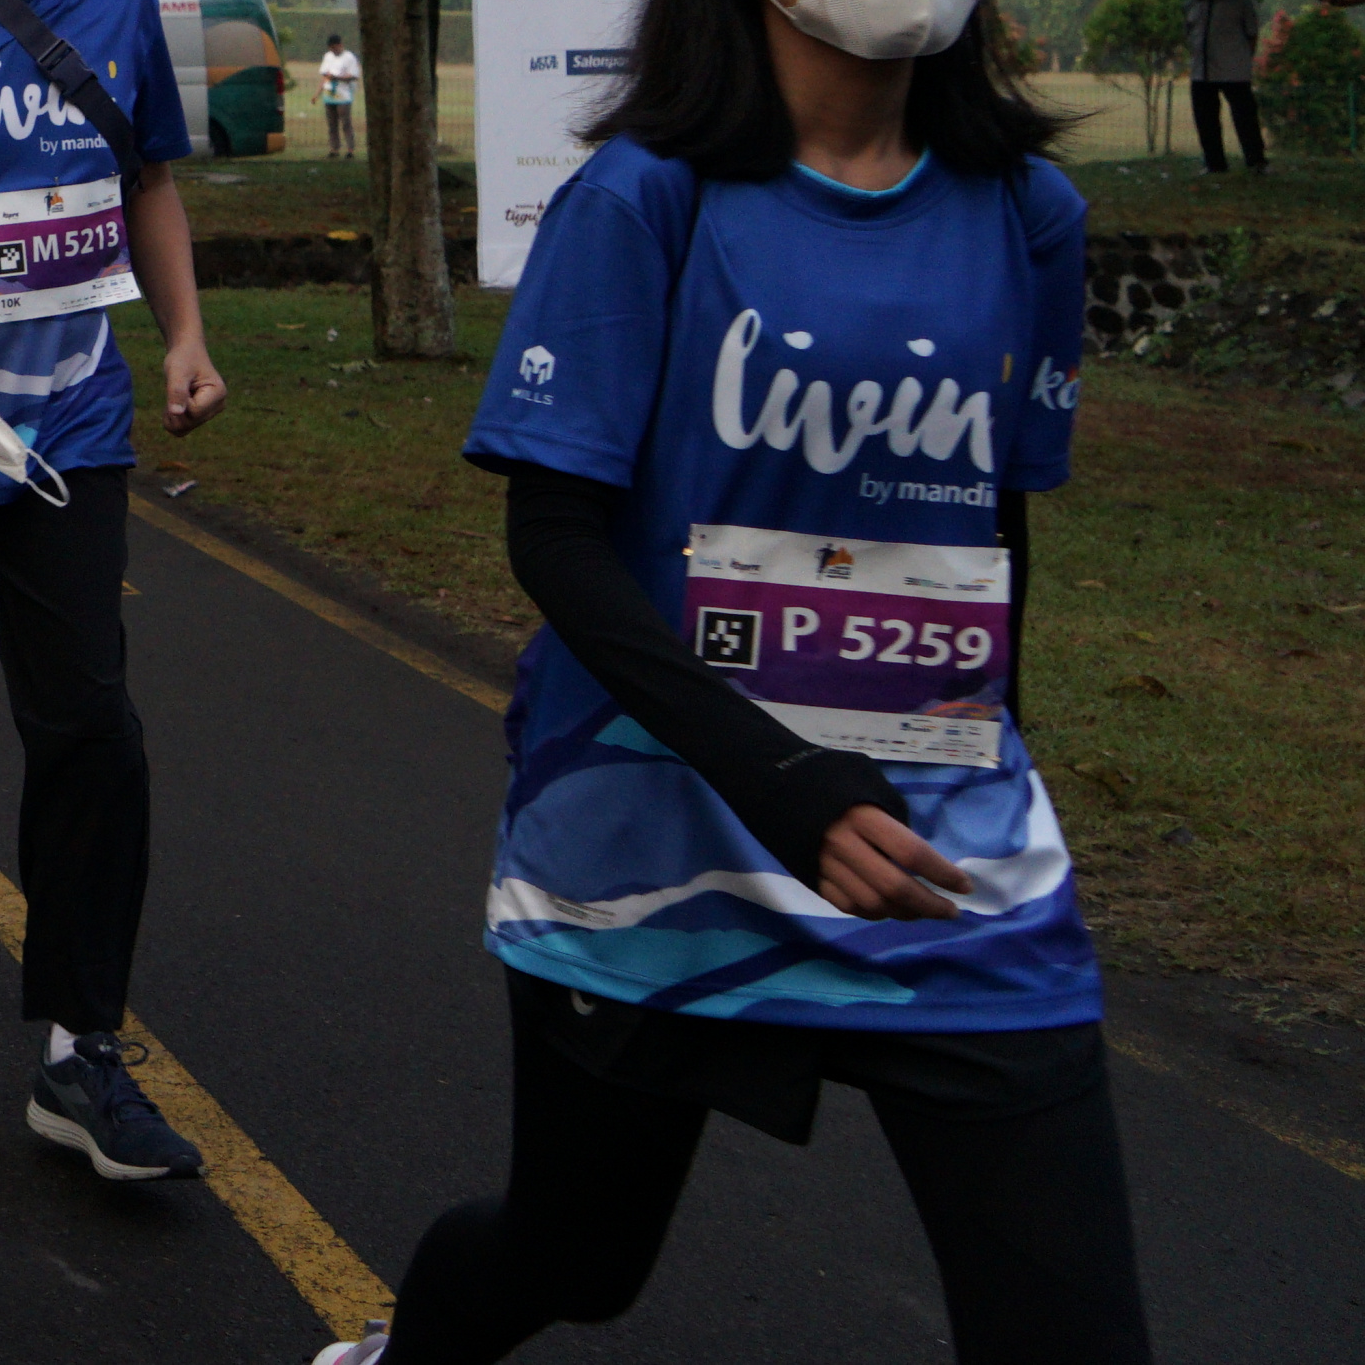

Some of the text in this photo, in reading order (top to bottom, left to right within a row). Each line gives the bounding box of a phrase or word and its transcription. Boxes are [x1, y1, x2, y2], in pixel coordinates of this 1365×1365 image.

[39, 136, 59, 156] by
[516, 155, 559, 167] ROYAL
[32, 221, 120, 263] M 5213
[0, 297, 22, 309] 10K
[859, 472, 893, 505] by
[781, 606, 993, 671] P 5259
